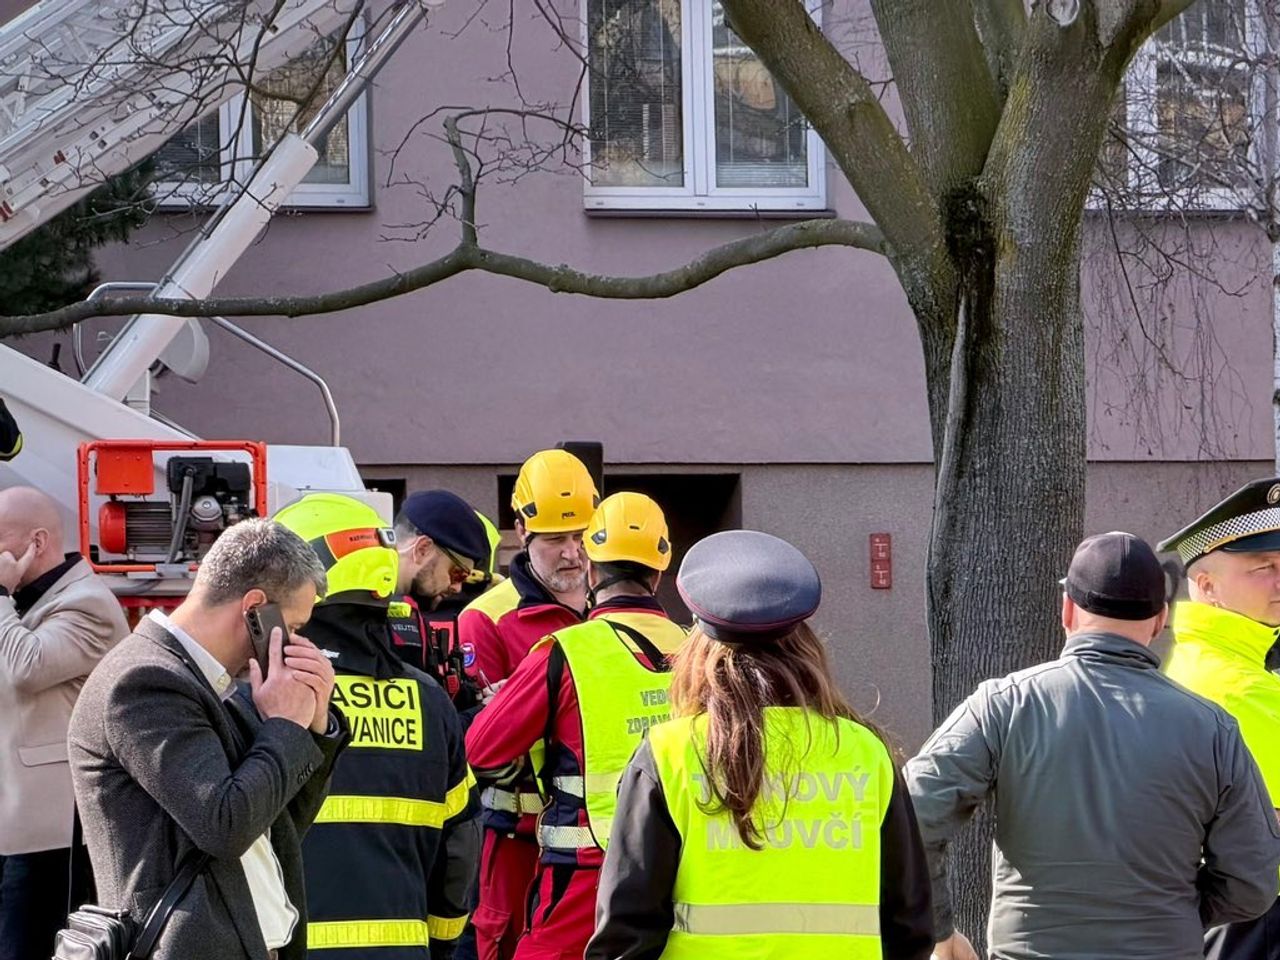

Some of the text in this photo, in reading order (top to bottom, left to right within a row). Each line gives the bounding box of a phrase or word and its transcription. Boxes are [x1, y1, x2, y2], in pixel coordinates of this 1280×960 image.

[640, 688, 668, 707] VED
[347, 716, 417, 745] VANICE
[692, 765, 870, 802] TKOVÝ
[707, 811, 863, 850] MUVČÍ
